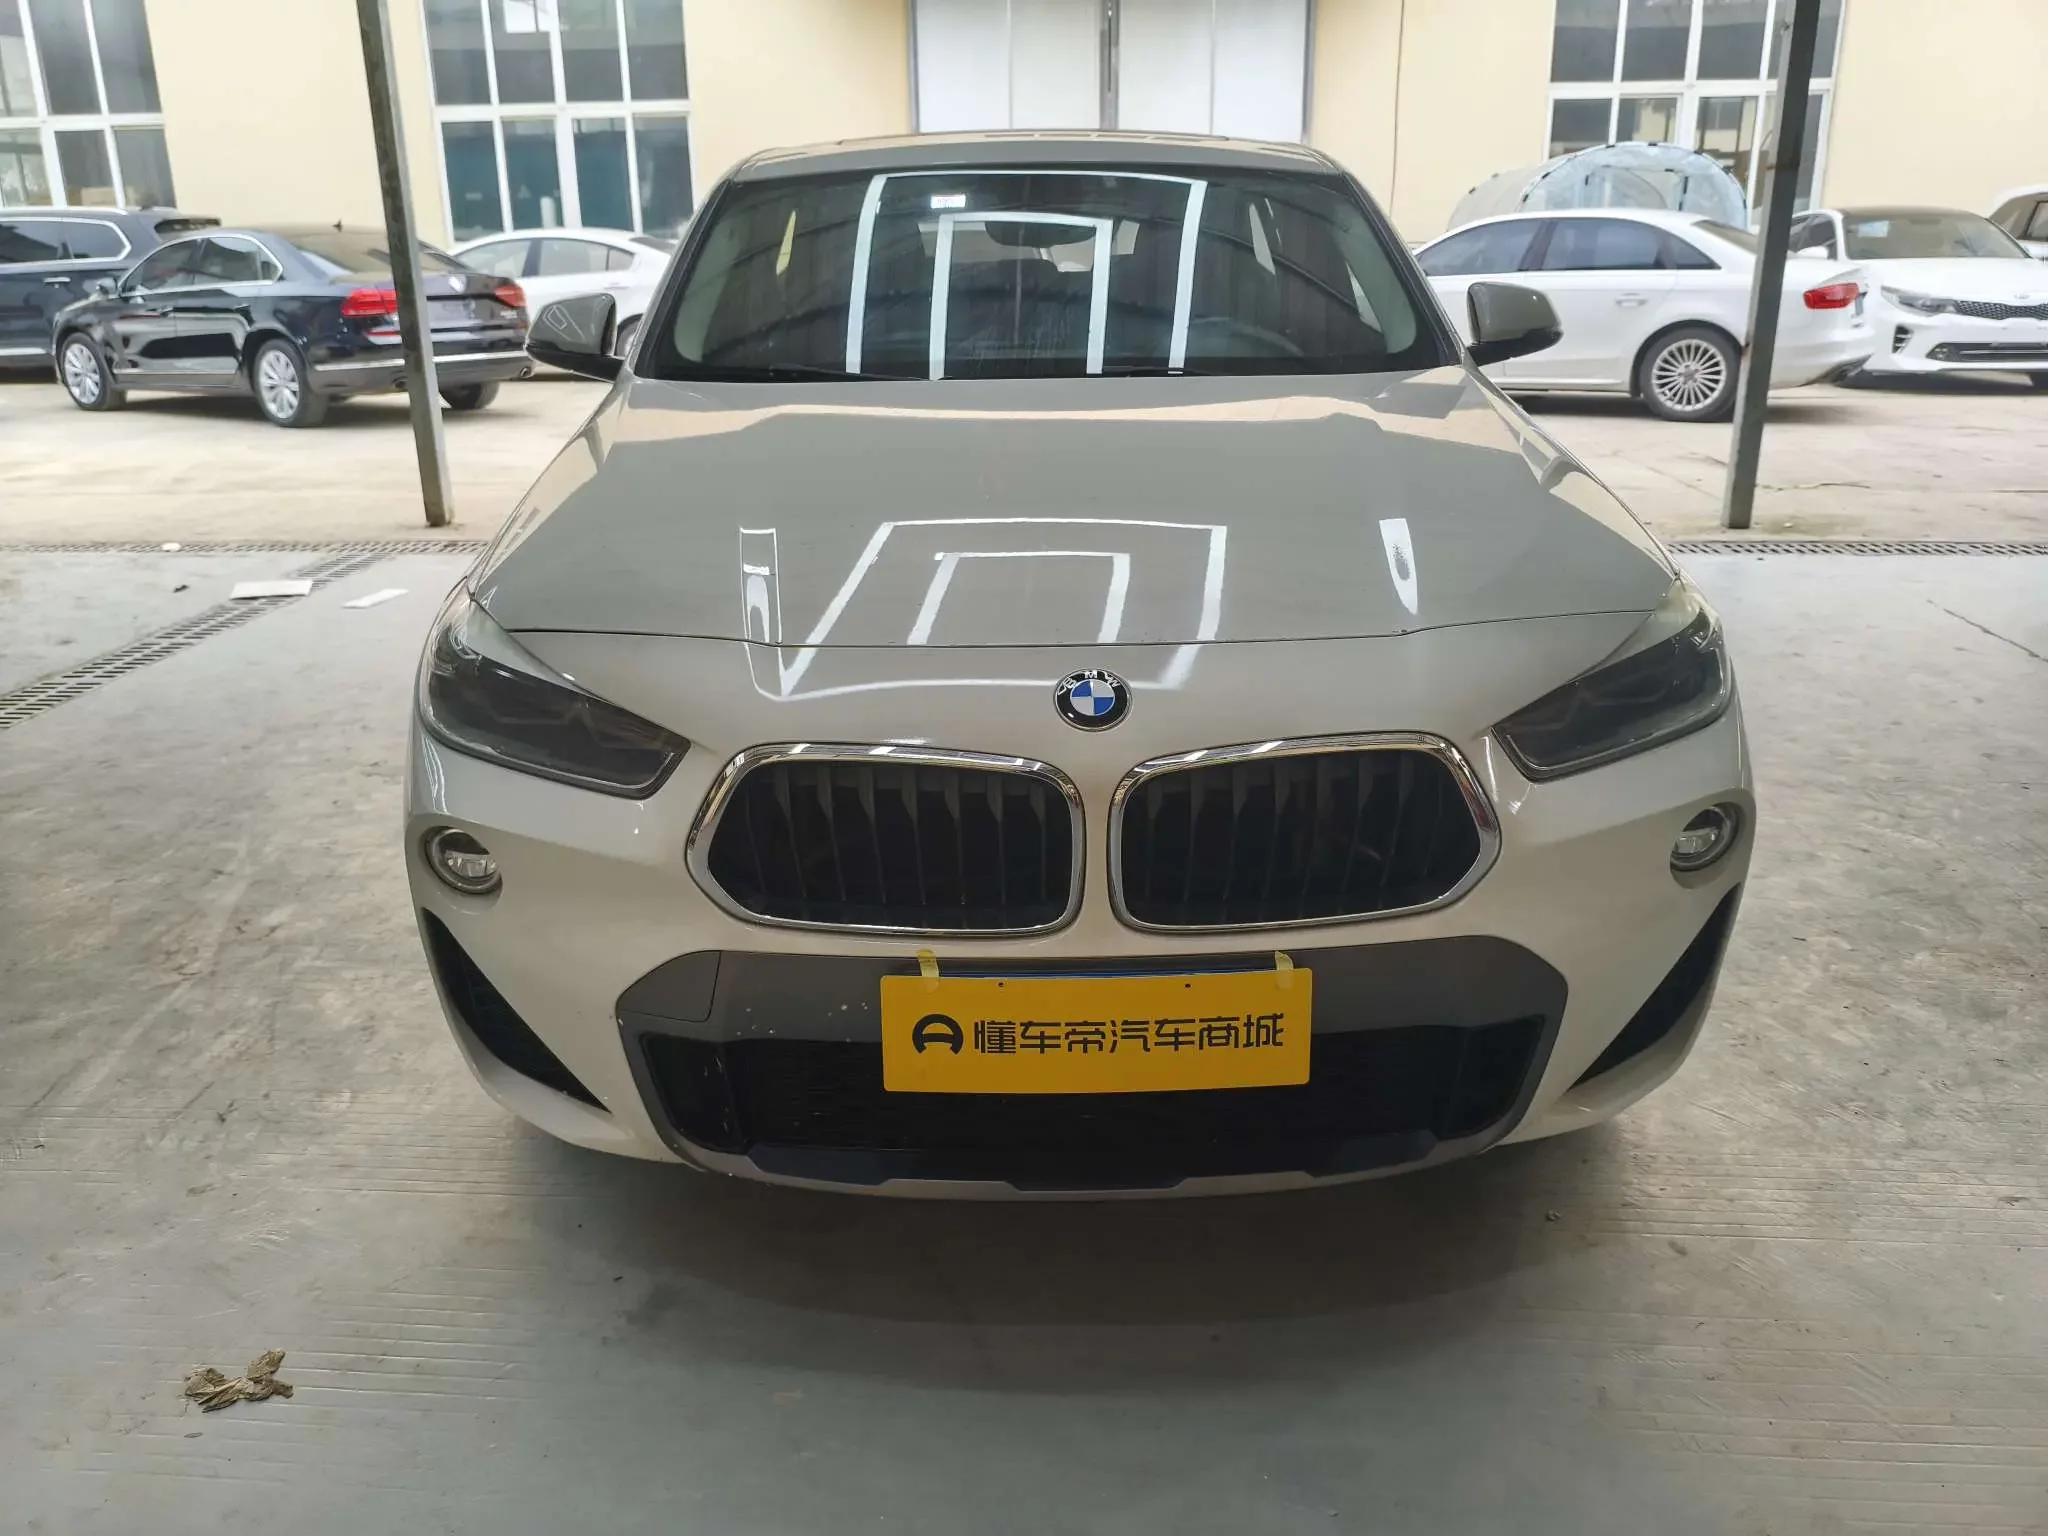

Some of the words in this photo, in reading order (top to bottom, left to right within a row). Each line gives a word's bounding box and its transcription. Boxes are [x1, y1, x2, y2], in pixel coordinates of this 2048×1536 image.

[1061, 669, 1121, 689] BMW
[973, 1012, 1285, 1055] 懂车帝汽车商城
